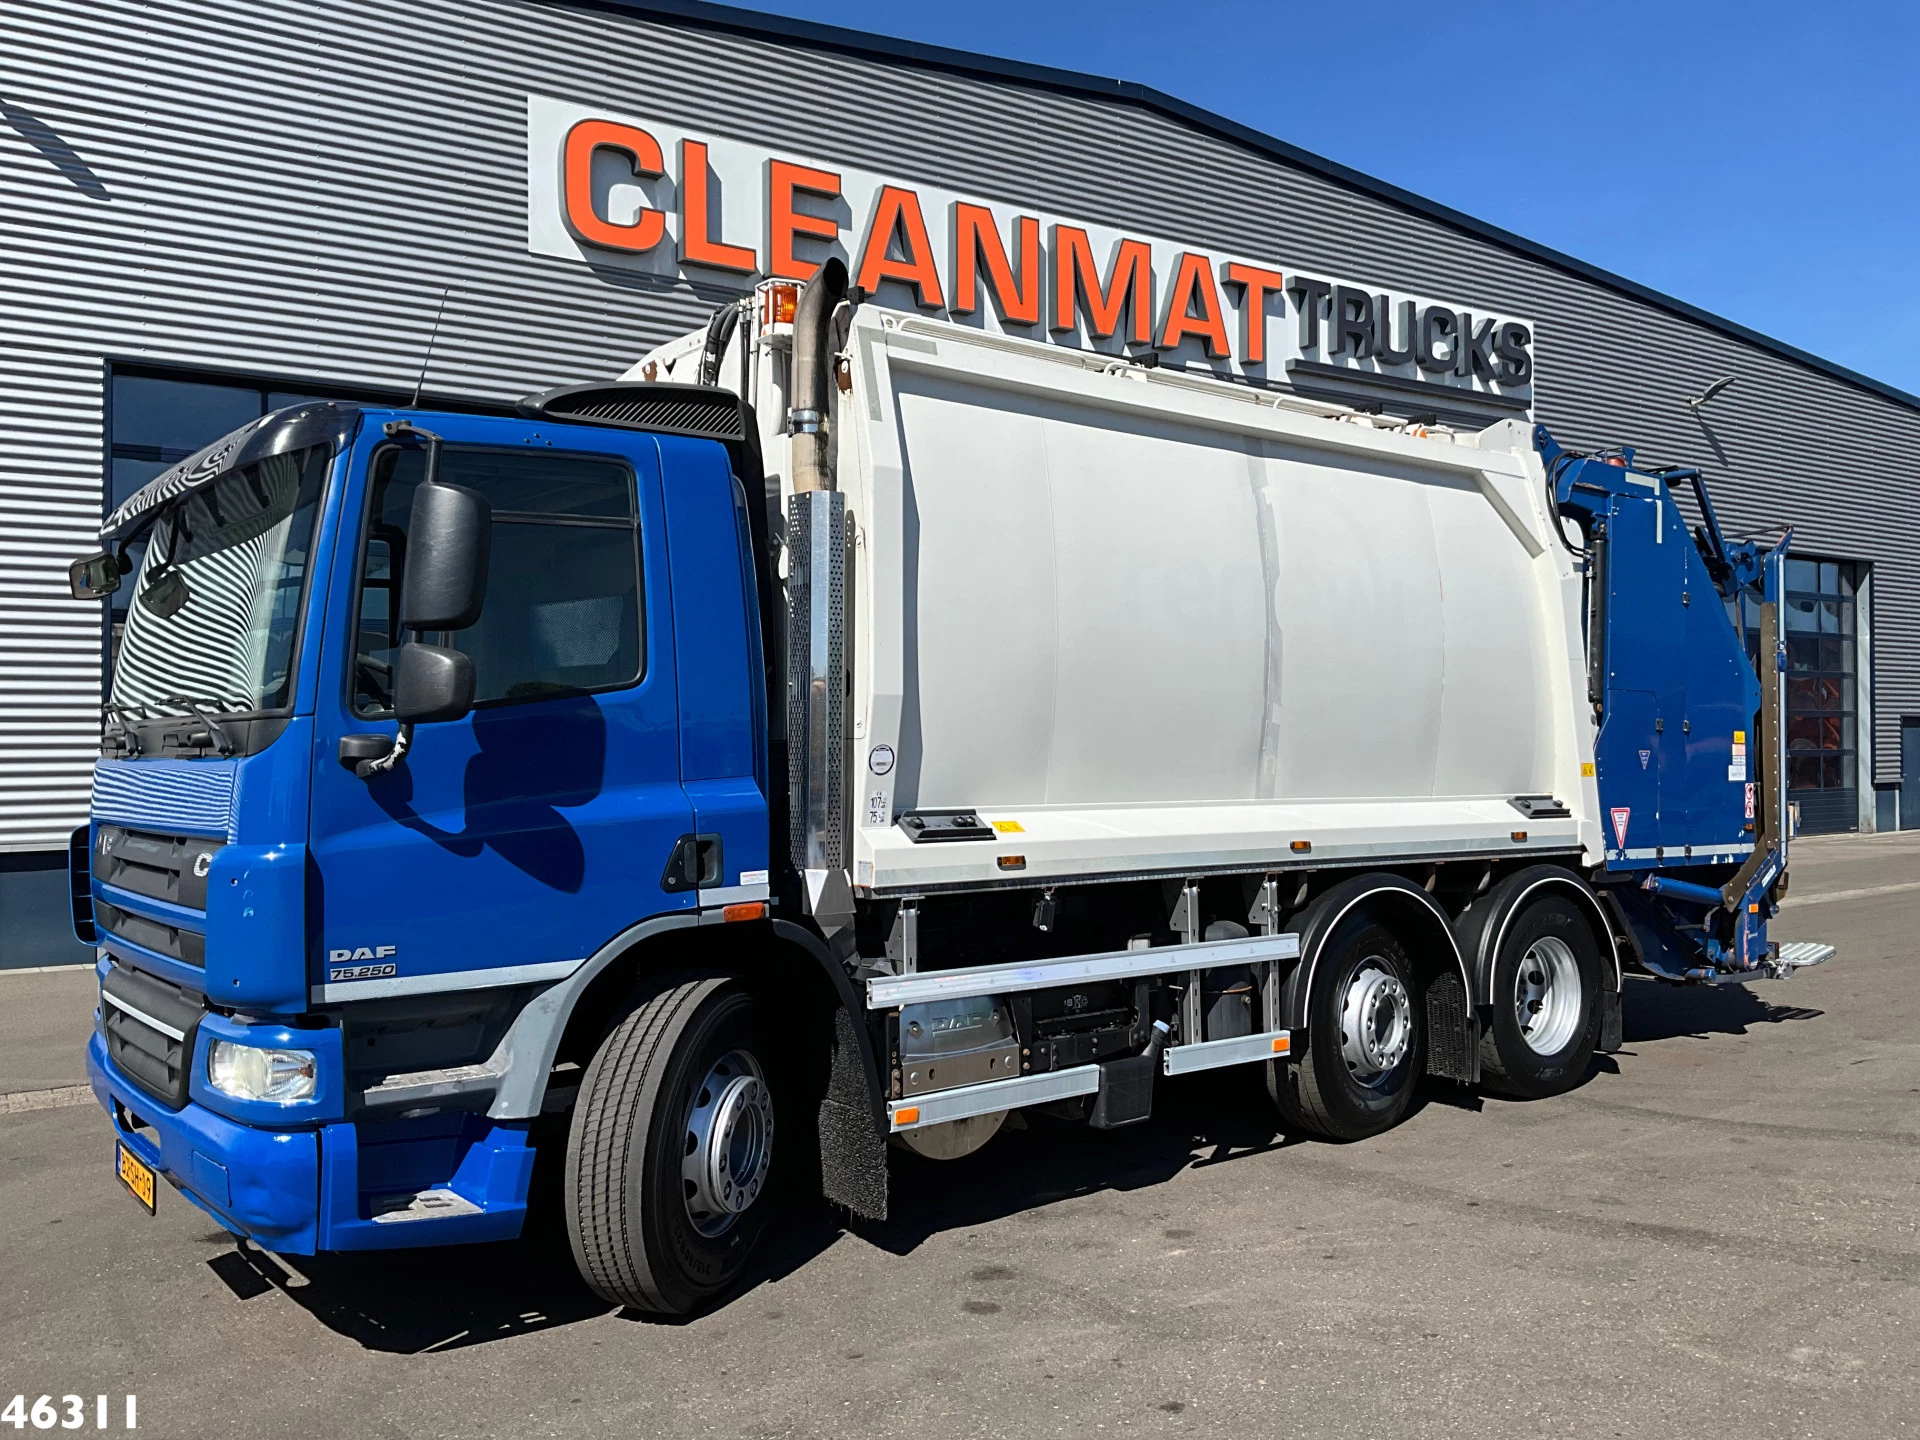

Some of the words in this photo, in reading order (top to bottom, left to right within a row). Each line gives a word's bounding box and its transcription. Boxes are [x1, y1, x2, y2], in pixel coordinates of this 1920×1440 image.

[558, 118, 1283, 365] CLEANMAT
[1286, 275, 1533, 387] TRUCKS
[329, 945, 396, 963] DAF
[331, 964, 396, 980] 75.250
